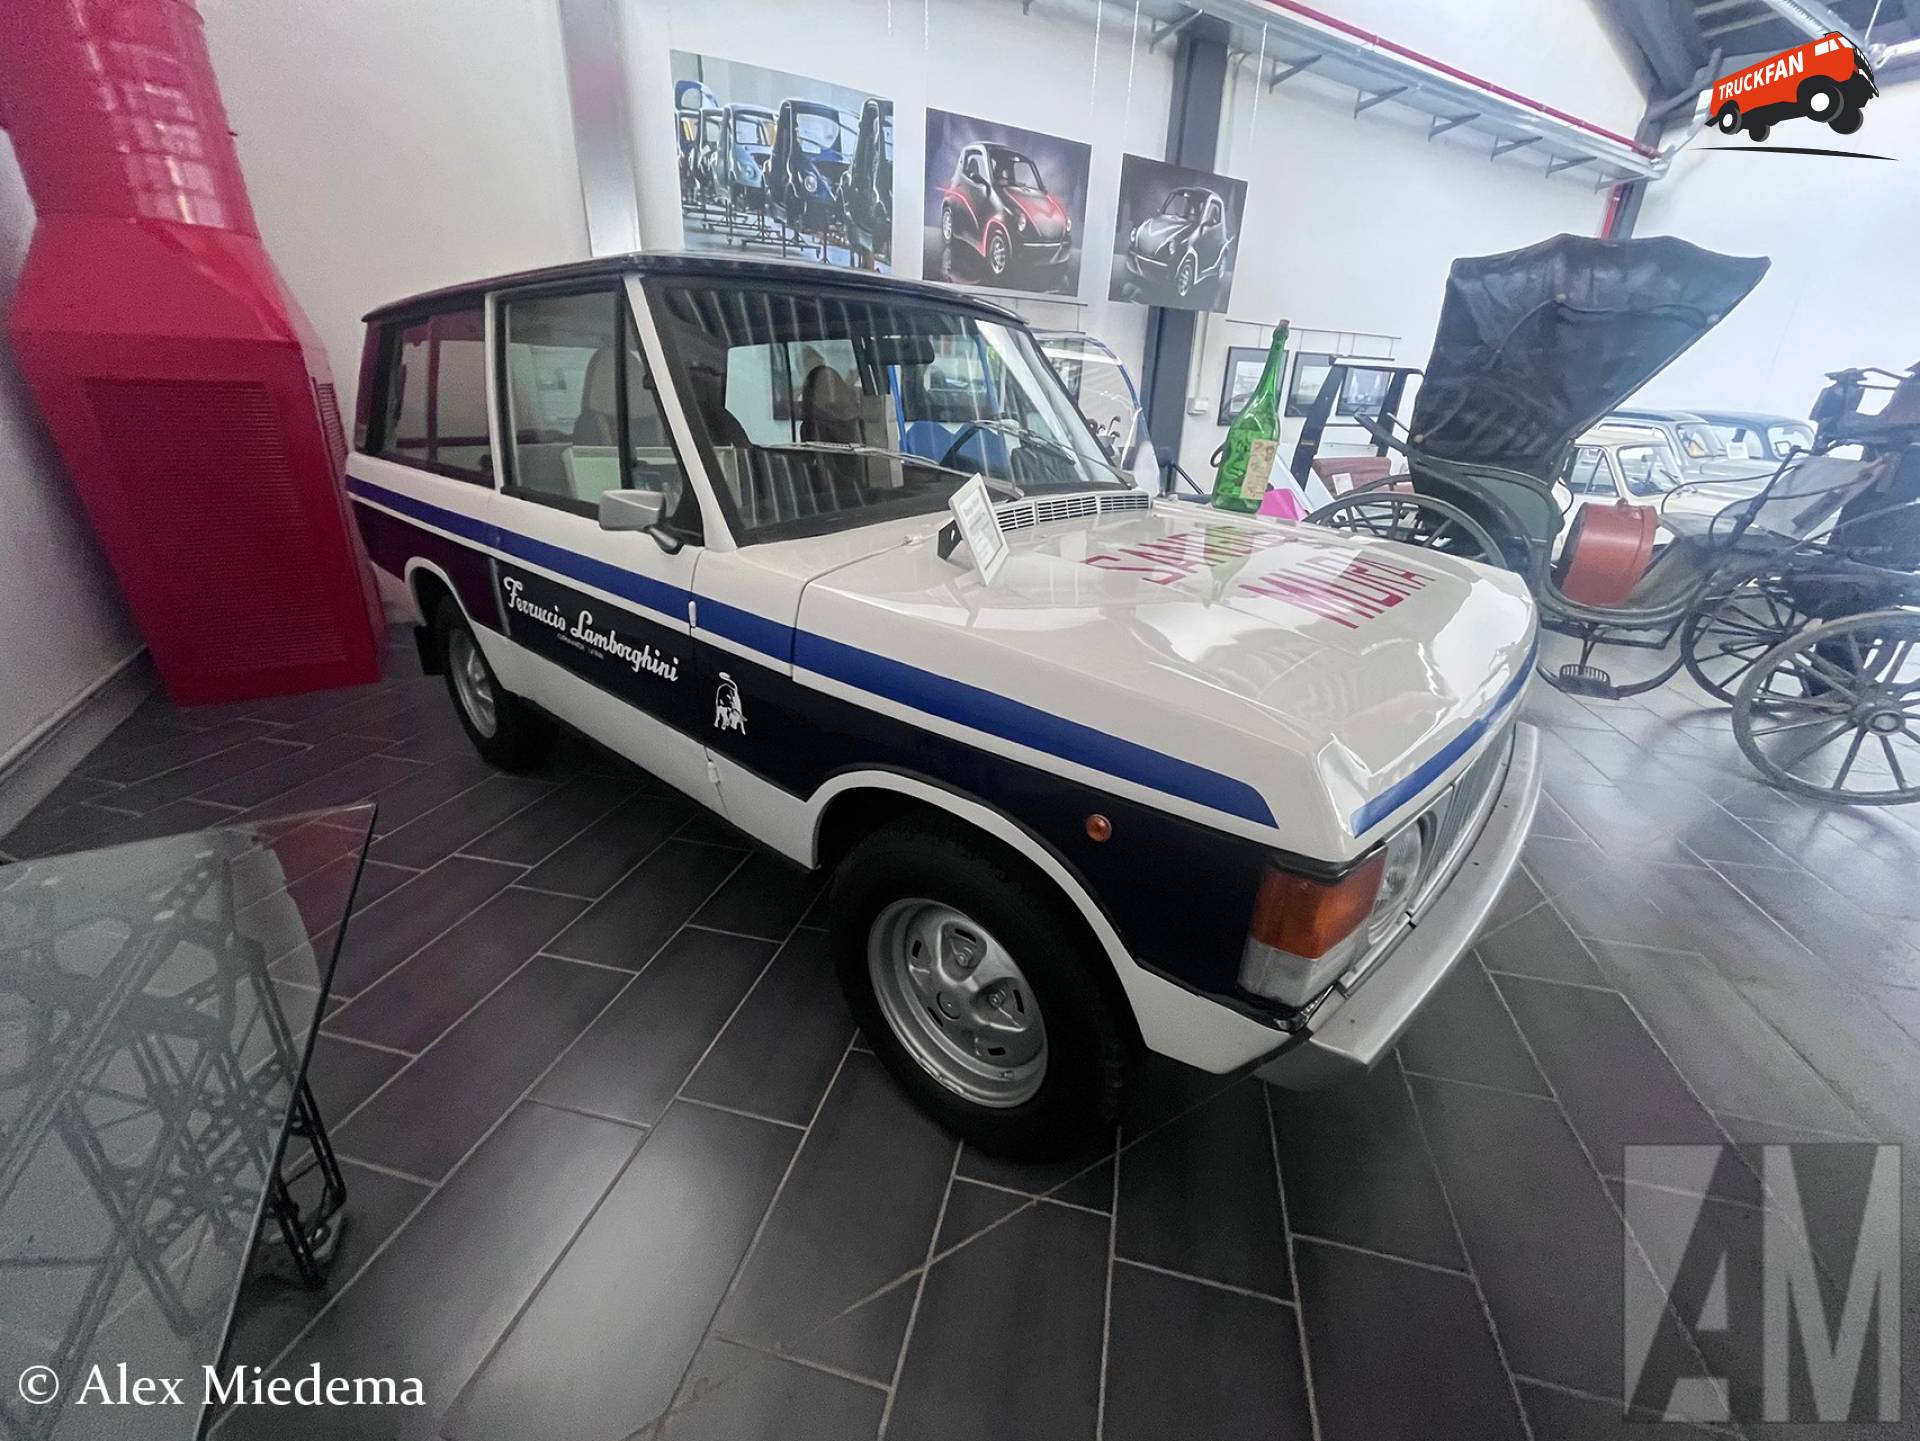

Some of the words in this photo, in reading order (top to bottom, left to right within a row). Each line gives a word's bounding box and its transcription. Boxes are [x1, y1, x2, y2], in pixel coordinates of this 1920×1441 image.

[503, 575, 566, 632] Ferruccio
[570, 610, 679, 682] Lamborghini
[1237, 551, 1436, 630] MIURA
